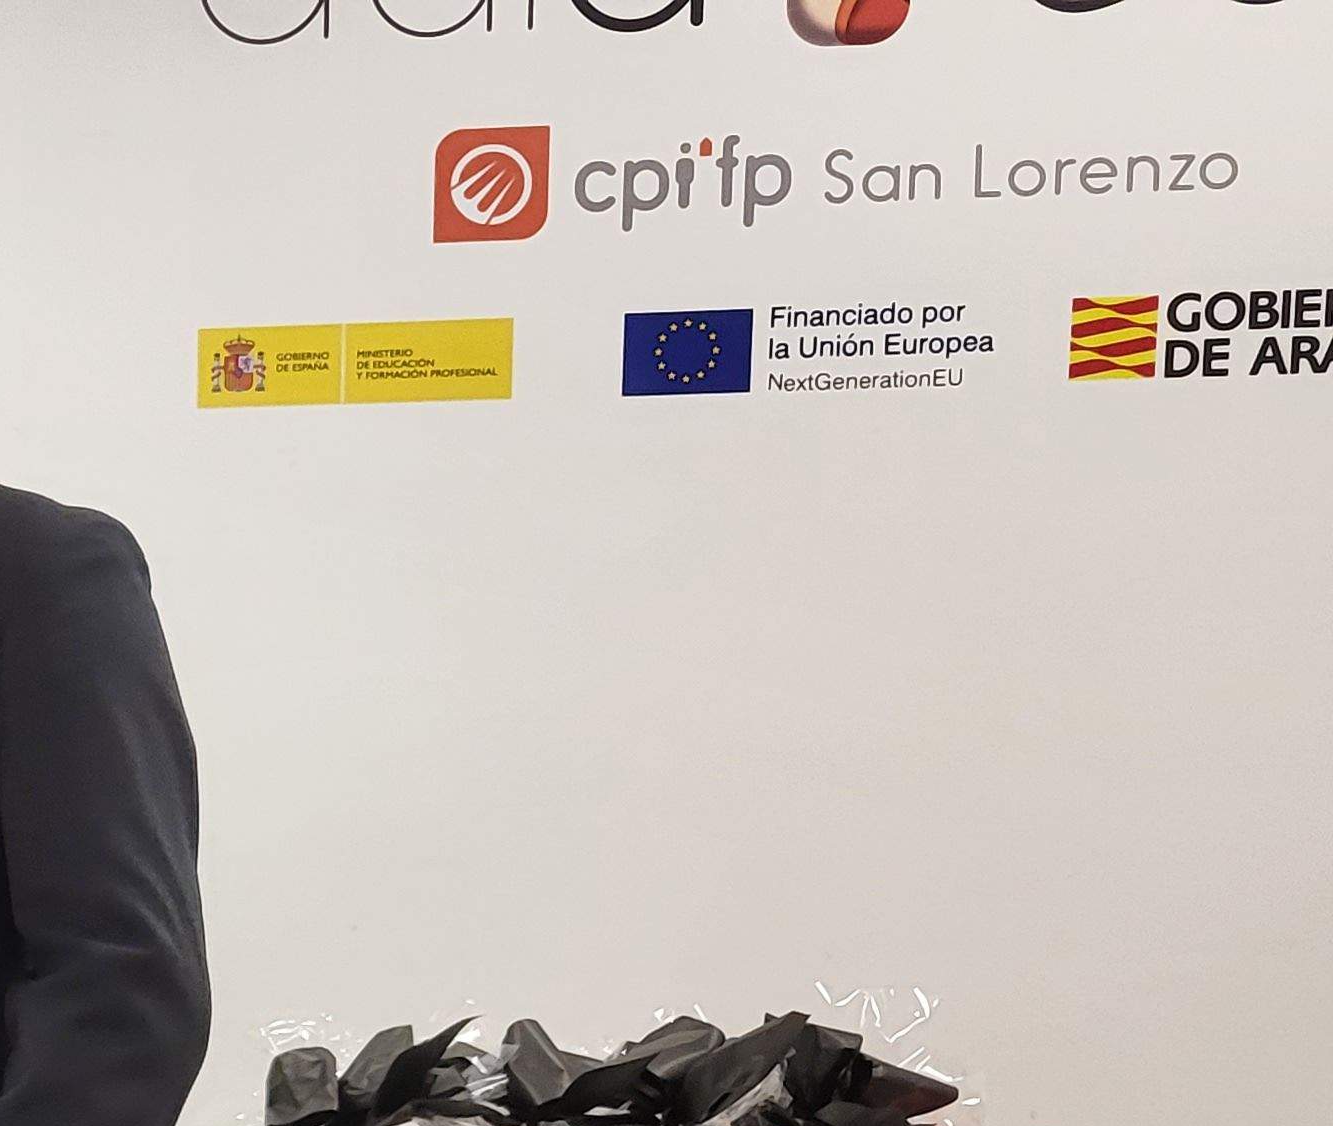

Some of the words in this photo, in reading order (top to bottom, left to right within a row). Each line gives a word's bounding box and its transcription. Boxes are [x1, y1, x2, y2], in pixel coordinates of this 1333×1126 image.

[825, 149, 941, 204] San
[975, 144, 1238, 197] Lorenzo
[770, 303, 913, 327] Financiado
[922, 304, 966, 327] por
[1167, 289, 1333, 332] GOBIE
[276, 351, 330, 361] GOBIERNO
[356, 349, 413, 359] MINISTERIO
[768, 338, 790, 359] la
[799, 335, 874, 358] Unión
[884, 333, 994, 358] Europea
[1164, 337, 1230, 378] DE
[276, 363, 289, 372] DE
[292, 361, 329, 372] ESPAÑA
[356, 361, 370, 370] DE
[356, 371, 363, 380] Y
[430, 366, 498, 377] PROFESIONAL
[767, 368, 963, 392] NextGenerationEU
